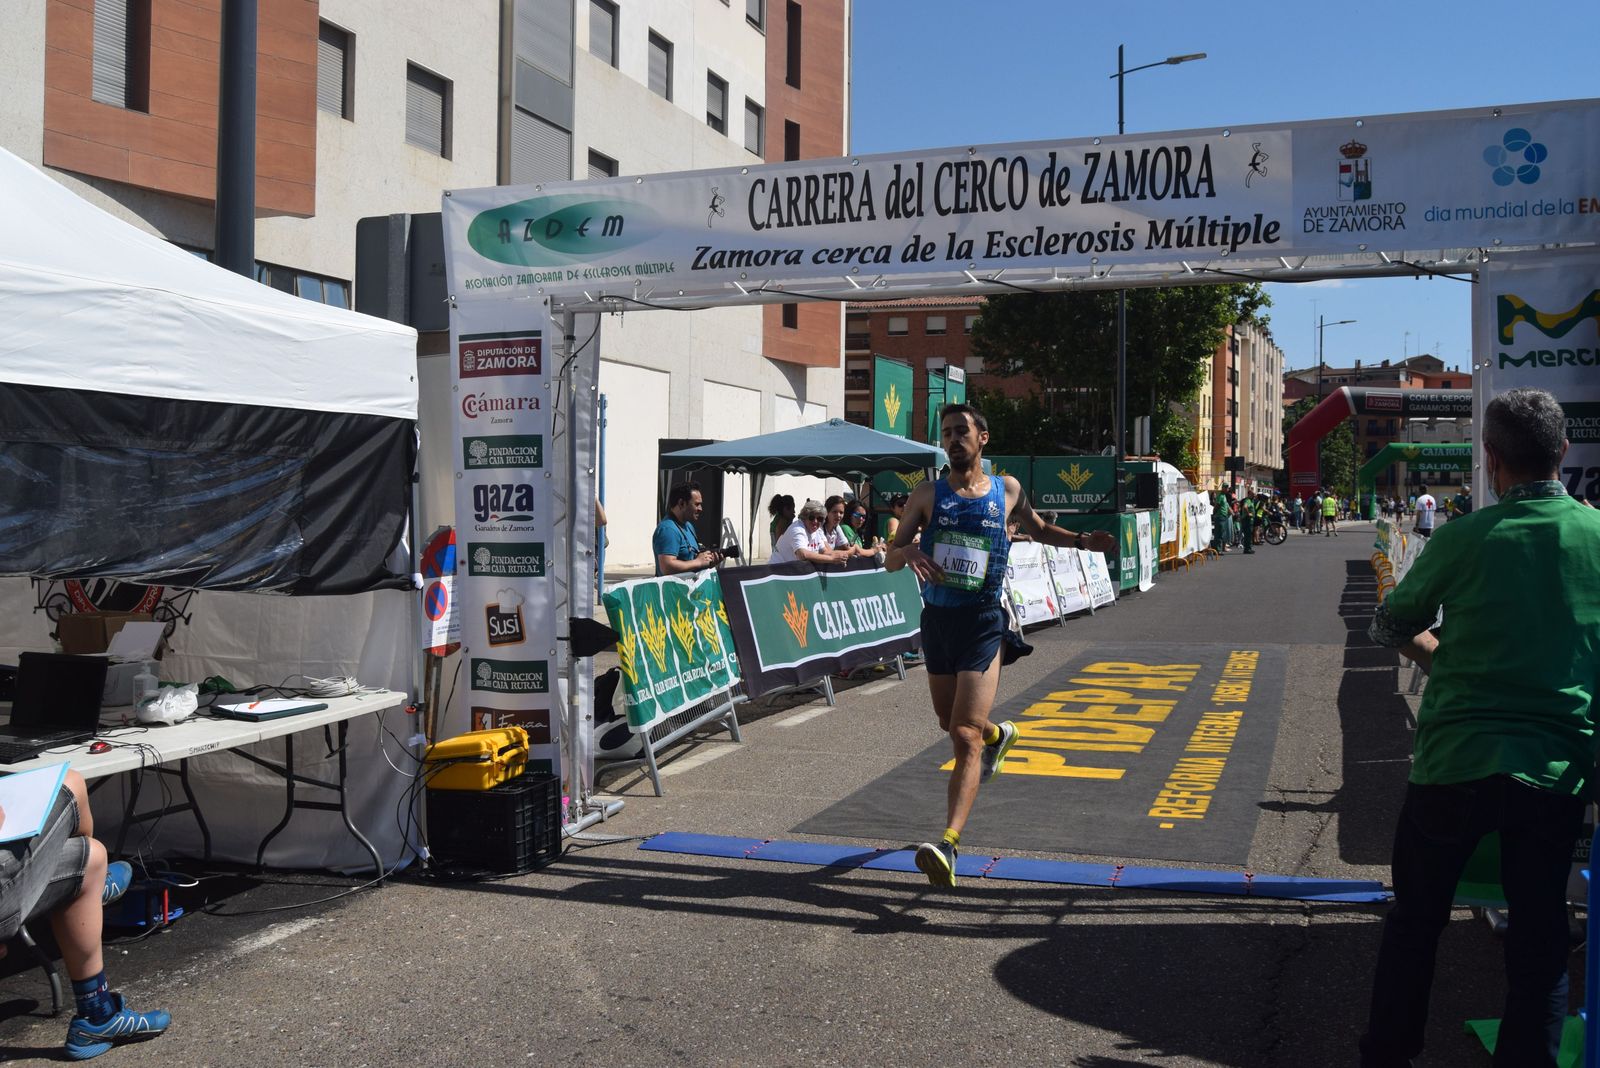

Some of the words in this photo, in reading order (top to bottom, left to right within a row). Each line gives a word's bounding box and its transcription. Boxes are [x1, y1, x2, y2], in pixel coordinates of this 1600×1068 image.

[748, 169, 876, 231] CARRERA
[885, 162, 924, 220] del
[934, 154, 1029, 217] CERCO
[1039, 155, 1071, 208] de
[1080, 144, 1216, 203] ZAMORA
[1304, 202, 1406, 218] AYUNTAMIENTO
[1455, 201, 1528, 220] mundial
[1532, 199, 1555, 216] de
[1558, 198, 1574, 215] la
[1304, 219, 1324, 233] DE
[1328, 216, 1406, 232] ZAMORA
[692, 245, 801, 271] Zamora
[812, 241, 892, 266] cerca
[901, 235, 936, 262] de
[947, 231, 973, 259] la
[984, 221, 1135, 259] Esclerosis
[1147, 213, 1281, 252] Múltiple
[465, 274, 513, 290] ASOCIACIÓN
[516, 270, 563, 285] ZAMORANA
[567, 270, 579, 281] DE
[583, 264, 631, 280] ESCLEROSIS
[635, 261, 675, 276] MÚLTIPLE
[477, 346, 523, 356] DIPUTACIÓN
[525, 346, 537, 354] DE
[477, 355, 537, 370] ZAMORA
[1409, 394, 1429, 402] CON
[1430, 394, 1439, 402] EL
[1409, 403, 1450, 411] GANAMOS
[490, 416, 513, 424] Zamora
[488, 446, 537, 456] FUNDACION
[488, 456, 504, 465] CAJA
[506, 455, 538, 464] RURAL
[473, 482, 535, 523] gaza
[1042, 493, 1069, 504] CAJA
[1071, 493, 1110, 504] RURAL
[491, 555, 540, 564] FUNDACION
[950, 557, 978, 575] NIETO
[491, 565, 506, 573] CAJA
[508, 565, 540, 573] RURAL
[812, 600, 856, 640] CAJA
[852, 592, 907, 632] RURAL
[490, 614, 520, 636] Susi
[492, 671, 543, 681] FUNDACION
[492, 680, 509, 689] CAJA
[511, 680, 543, 690] RURAL
[498, 713, 548, 729] Faiña
[1184, 710, 1244, 753] INTEGRAL
[1148, 757, 1228, 819] REFORMA
